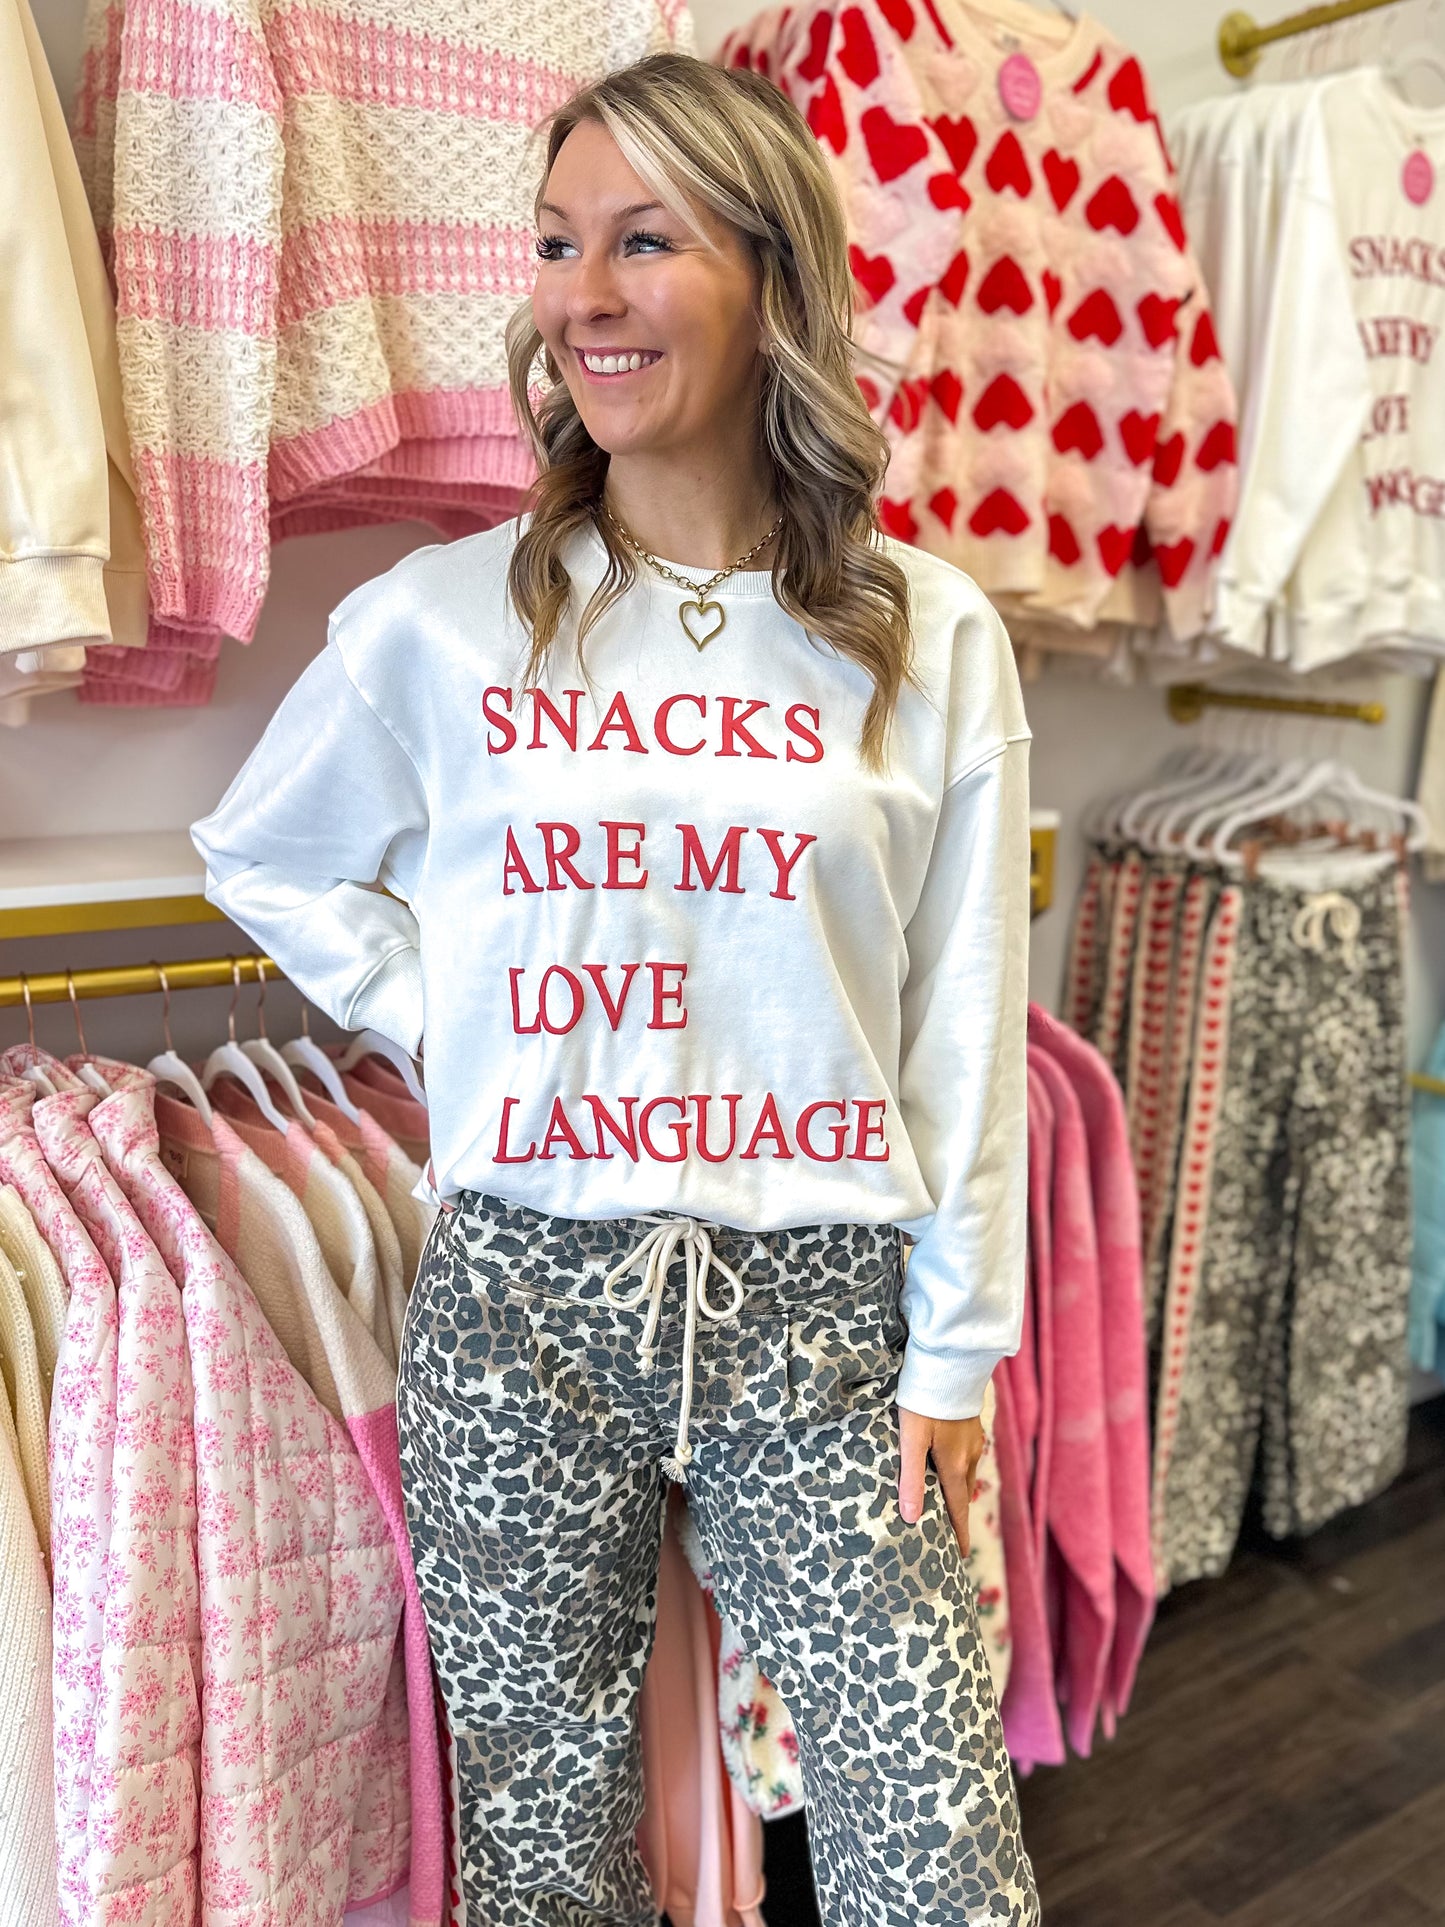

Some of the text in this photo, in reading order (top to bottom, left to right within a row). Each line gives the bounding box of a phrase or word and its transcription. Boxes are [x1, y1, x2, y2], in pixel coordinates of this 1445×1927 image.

[481, 686, 825, 764] SNACKS
[502, 821, 818, 901] ARE MY
[508, 962, 688, 1035] LOVE
[492, 1092, 890, 1164] LANGUAGE
